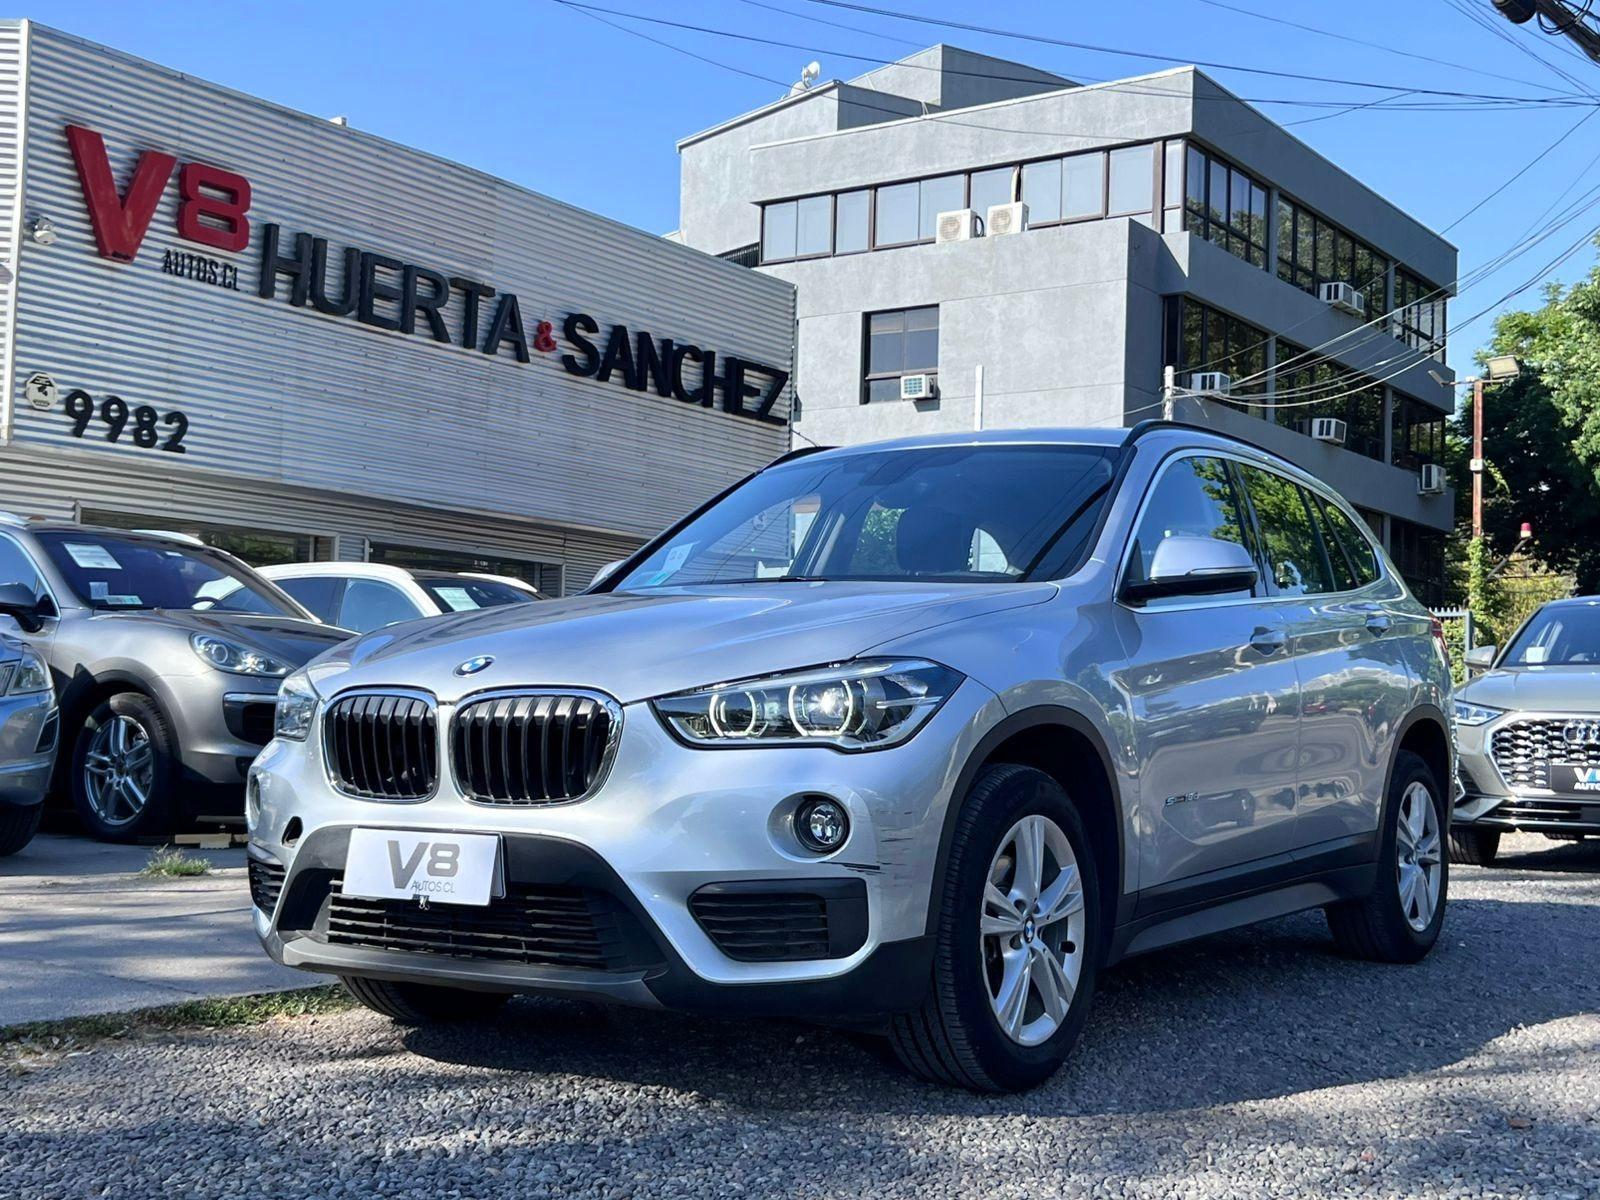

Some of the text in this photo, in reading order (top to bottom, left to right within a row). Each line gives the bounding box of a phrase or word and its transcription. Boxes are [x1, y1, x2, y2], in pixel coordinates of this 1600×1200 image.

[66, 125, 251, 264] V8
[163, 250, 240, 291] AUTOS.CL
[259, 223, 788, 426] HUERTA & SANCHEZ
[65, 389, 189, 452] 9982
[388, 840, 460, 889] V8
